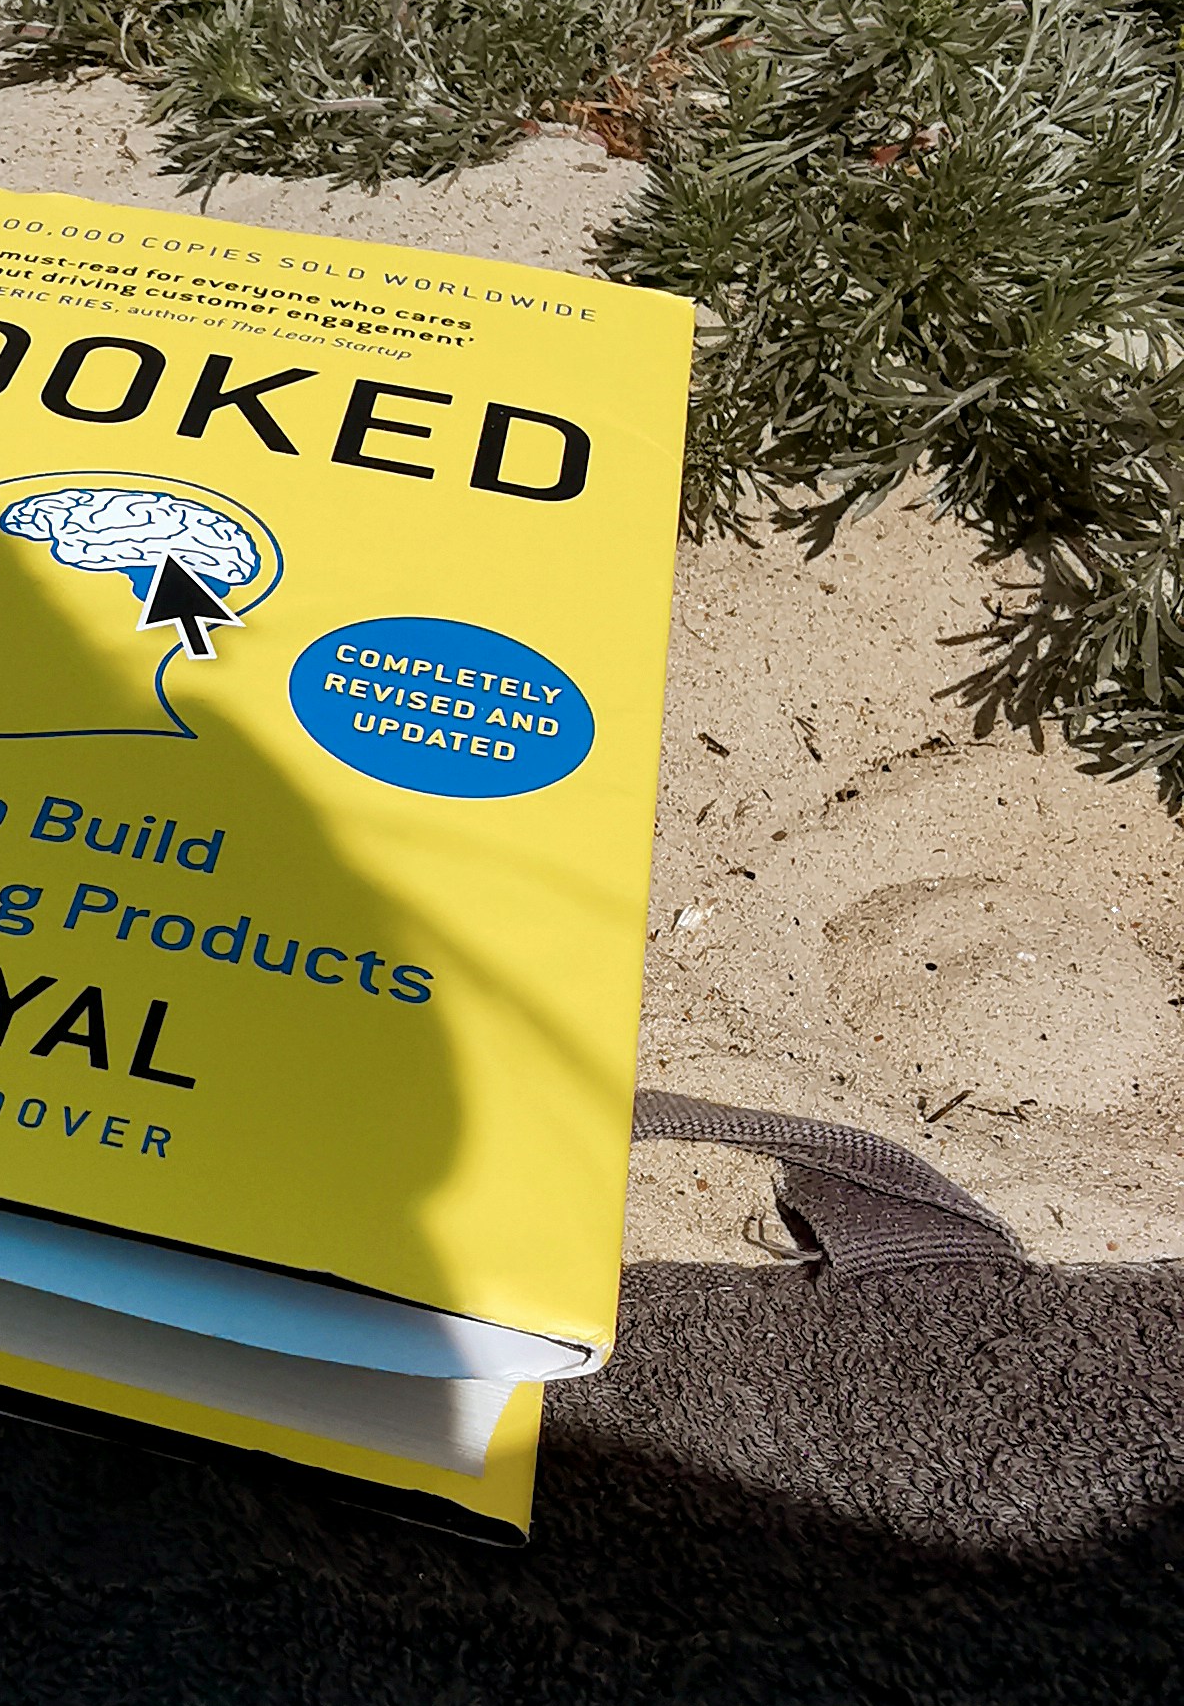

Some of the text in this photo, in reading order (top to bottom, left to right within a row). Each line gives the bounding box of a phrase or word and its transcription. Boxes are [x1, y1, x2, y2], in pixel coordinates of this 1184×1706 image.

[41, 272, 136, 297] driving
[145, 287, 279, 314] customer
[142, 236, 263, 264] COPIES
[279, 256, 366, 280] SOLD
[384, 272, 597, 323] WORLDWIDE
[146, 269, 184, 283] for
[192, 276, 321, 304] everyone
[330, 298, 386, 316] who
[395, 309, 472, 330] cares
[58, 294, 120, 313] RIES,
[127, 306, 197, 324] author
[203, 317, 227, 328] of
[231, 320, 267, 335] The
[273, 327, 326, 345] Lean
[331, 337, 412, 361] Startup
[324, 673, 559, 737] REVISED AND
[336, 644, 562, 705] COMPLETELY
[353, 712, 515, 762] UPDATED
[30, 796, 226, 876] Build
[63, 884, 435, 1006] Products
